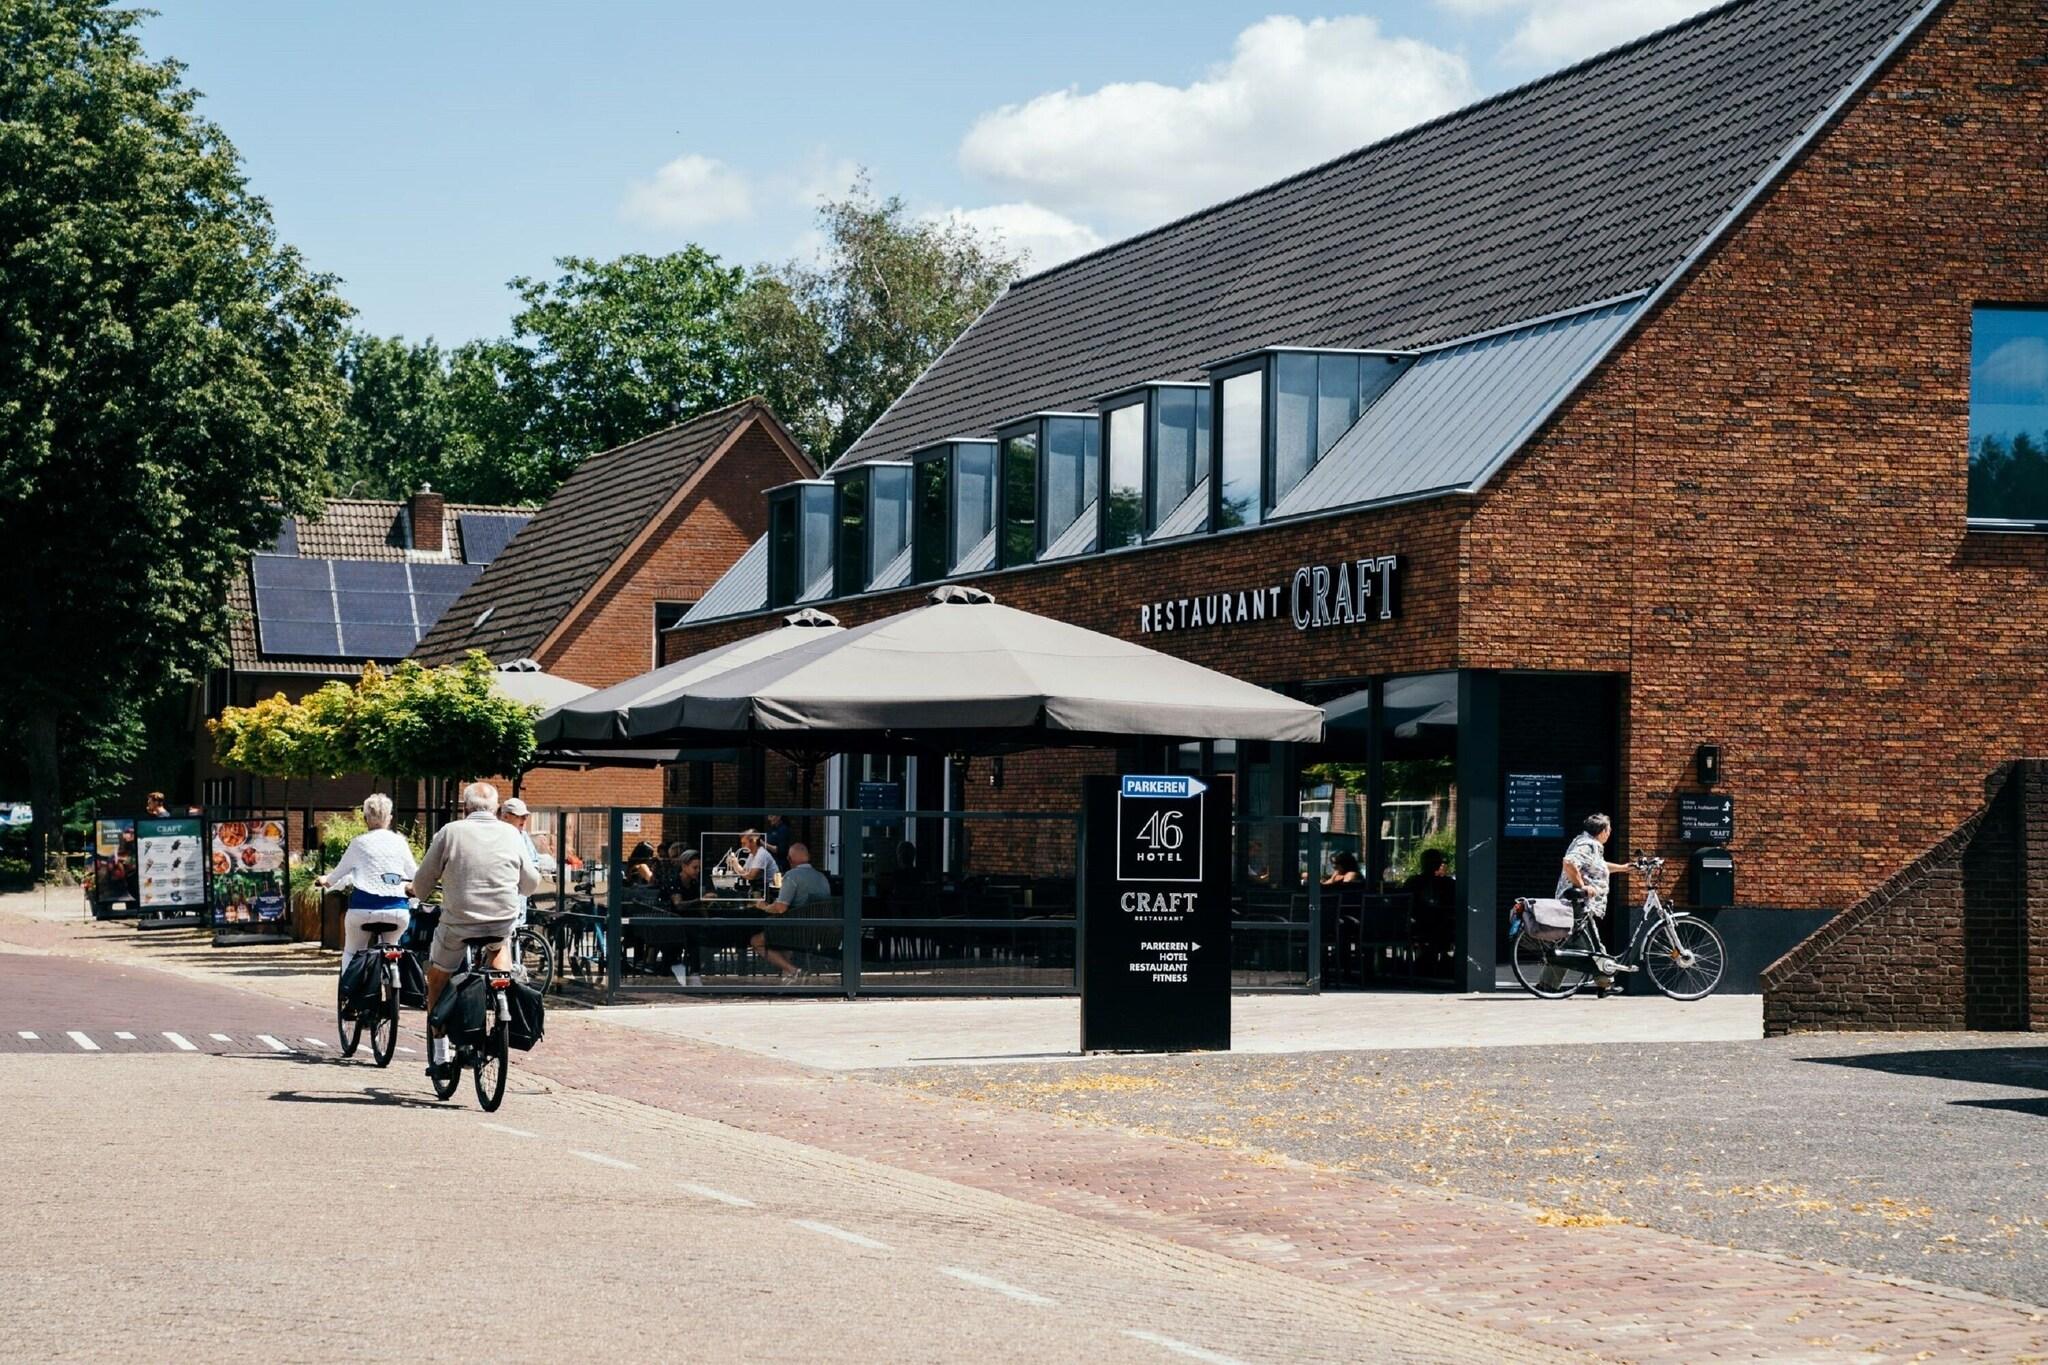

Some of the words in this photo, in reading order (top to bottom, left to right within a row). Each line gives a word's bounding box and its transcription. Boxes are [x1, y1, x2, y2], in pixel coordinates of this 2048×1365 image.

[1141, 586, 1281, 633] RESTAURANT
[1292, 555, 1397, 630] CRAFT
[1127, 780, 1186, 793] PARKEREN
[156, 824, 183, 833] CRAFT
[1136, 810, 1184, 850] 46
[1136, 852, 1183, 862] HOTEL
[1120, 891, 1198, 913] CRAFT
[1140, 941, 1189, 951] PARKEREN
[1159, 952, 1188, 962] HOTEL
[1129, 962, 1188, 972] RESTAURANT
[1152, 973, 1188, 983] FITNESS
